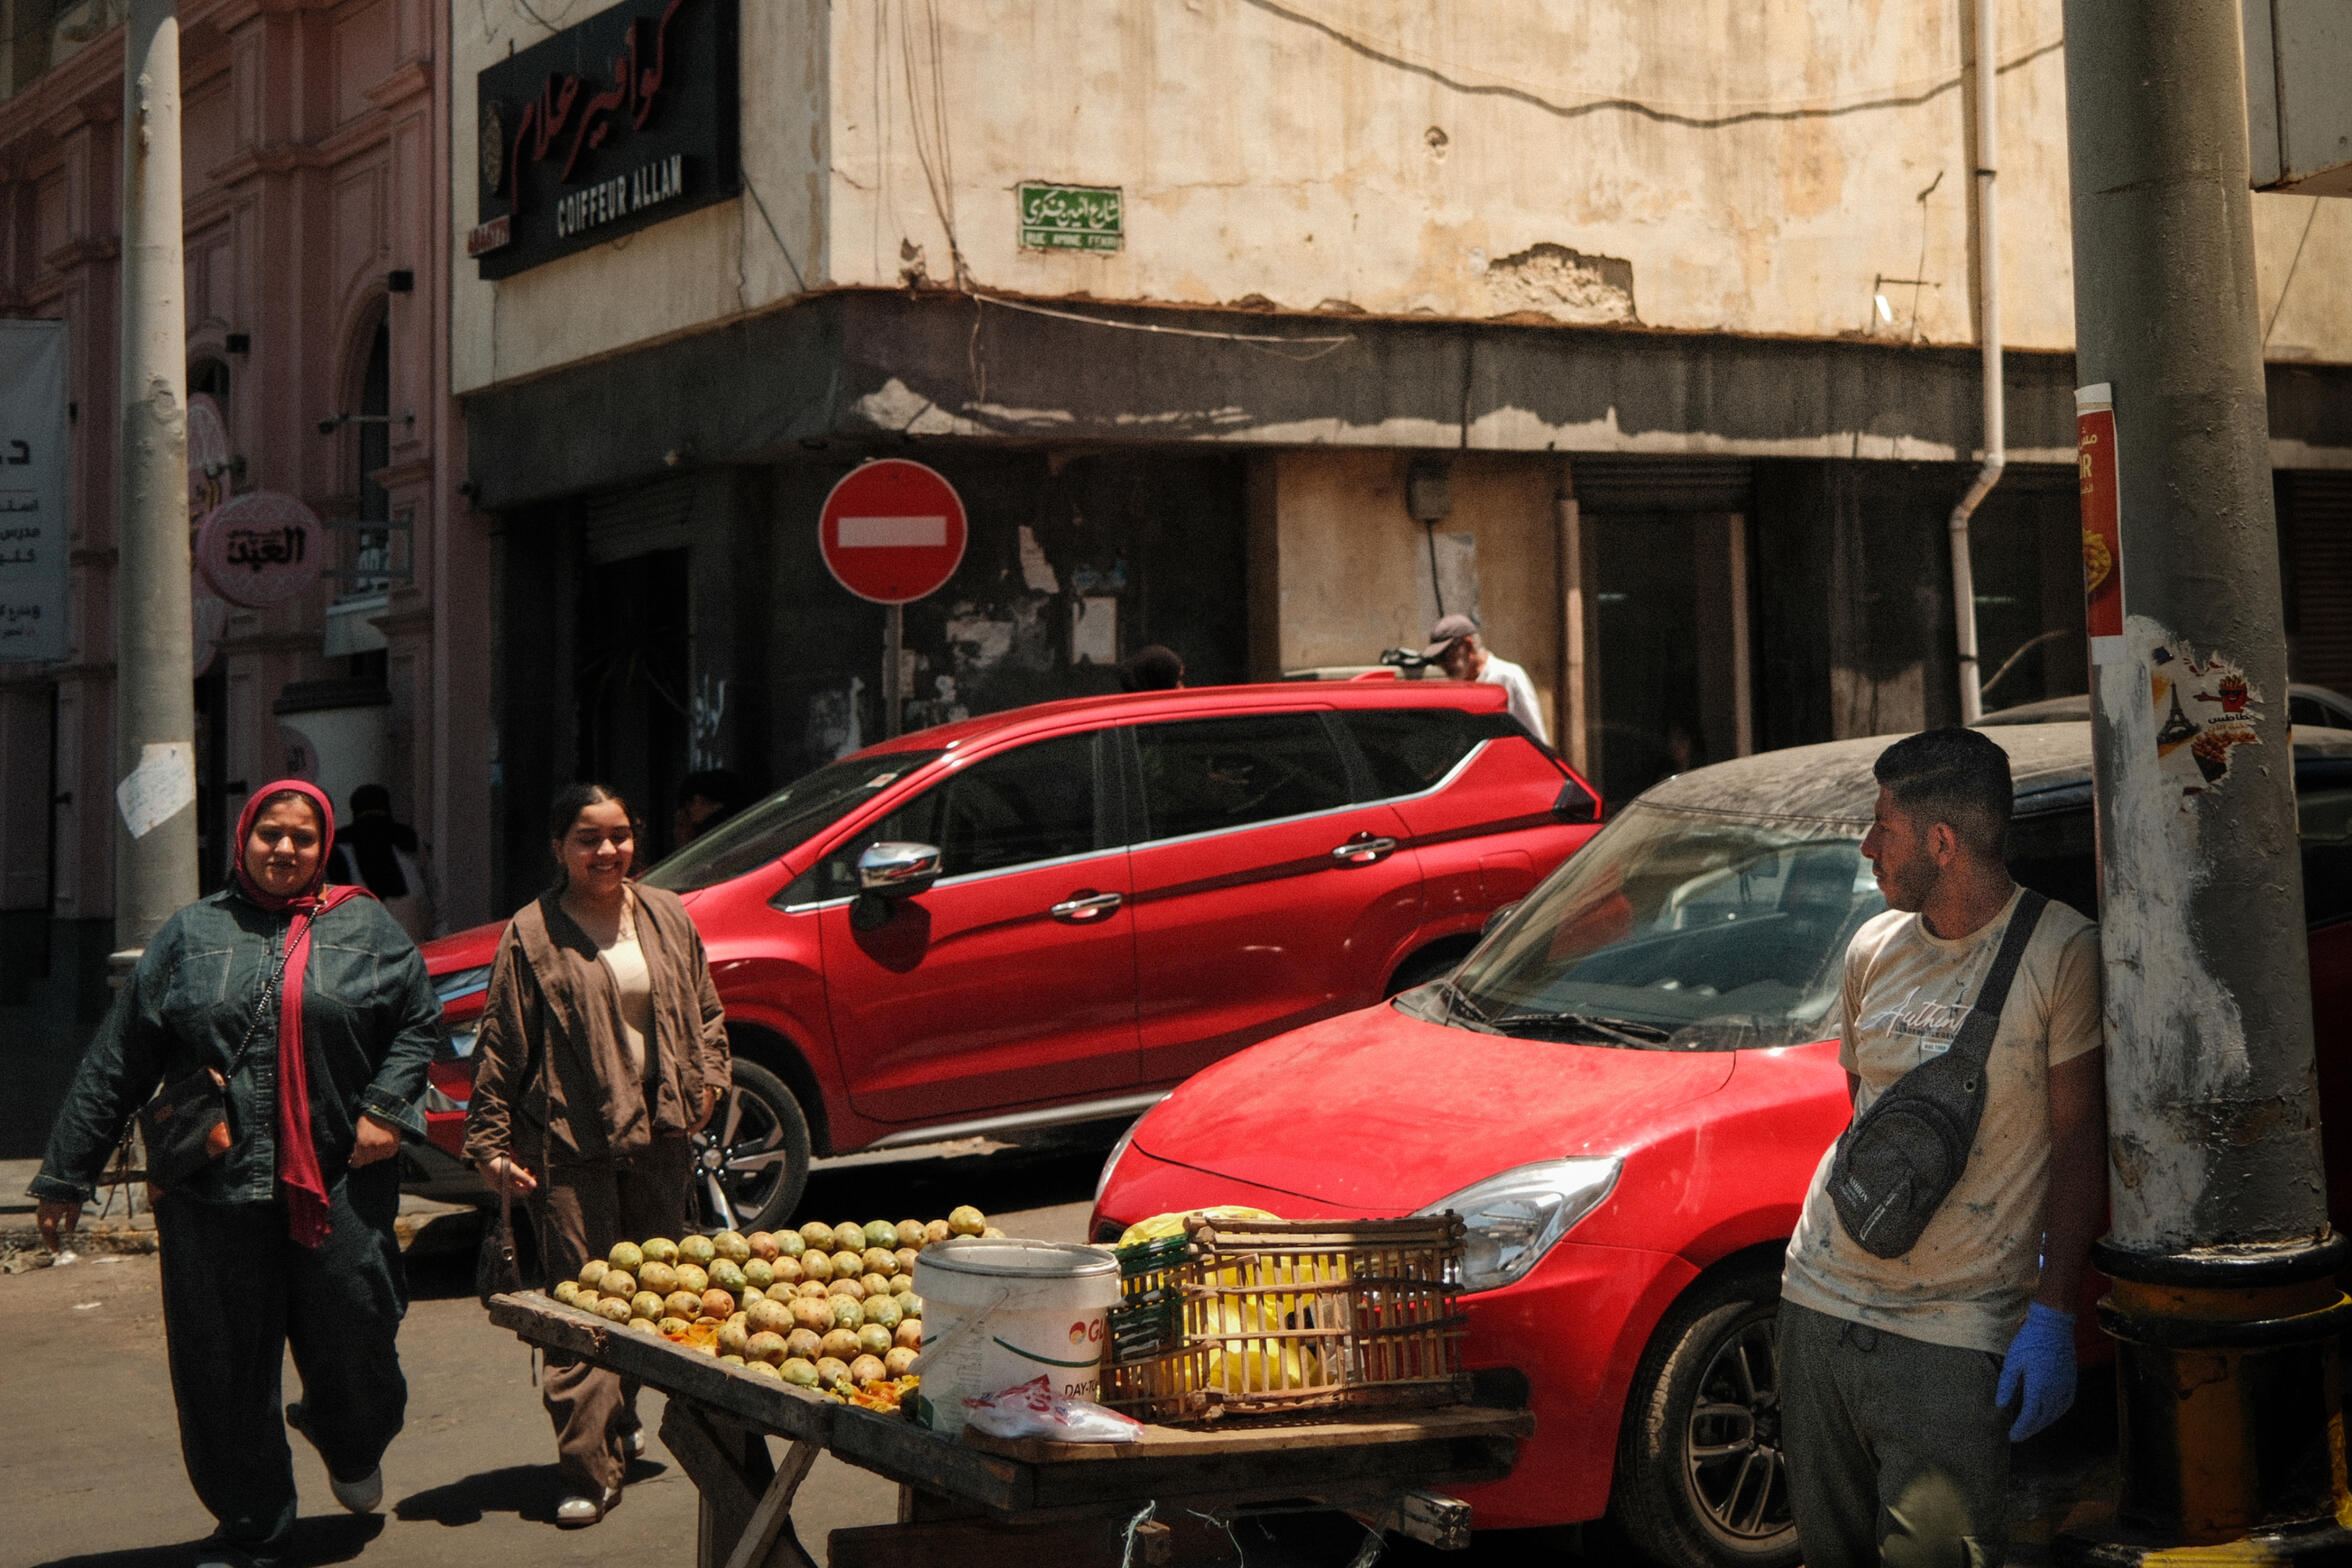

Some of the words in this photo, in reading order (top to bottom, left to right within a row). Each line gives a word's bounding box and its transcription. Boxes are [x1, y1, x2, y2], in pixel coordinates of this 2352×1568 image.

[558, 174, 628, 239] COIFFEUR
[632, 153, 683, 213] ALLAM
[2208, 713, 2252, 724] طاطس
